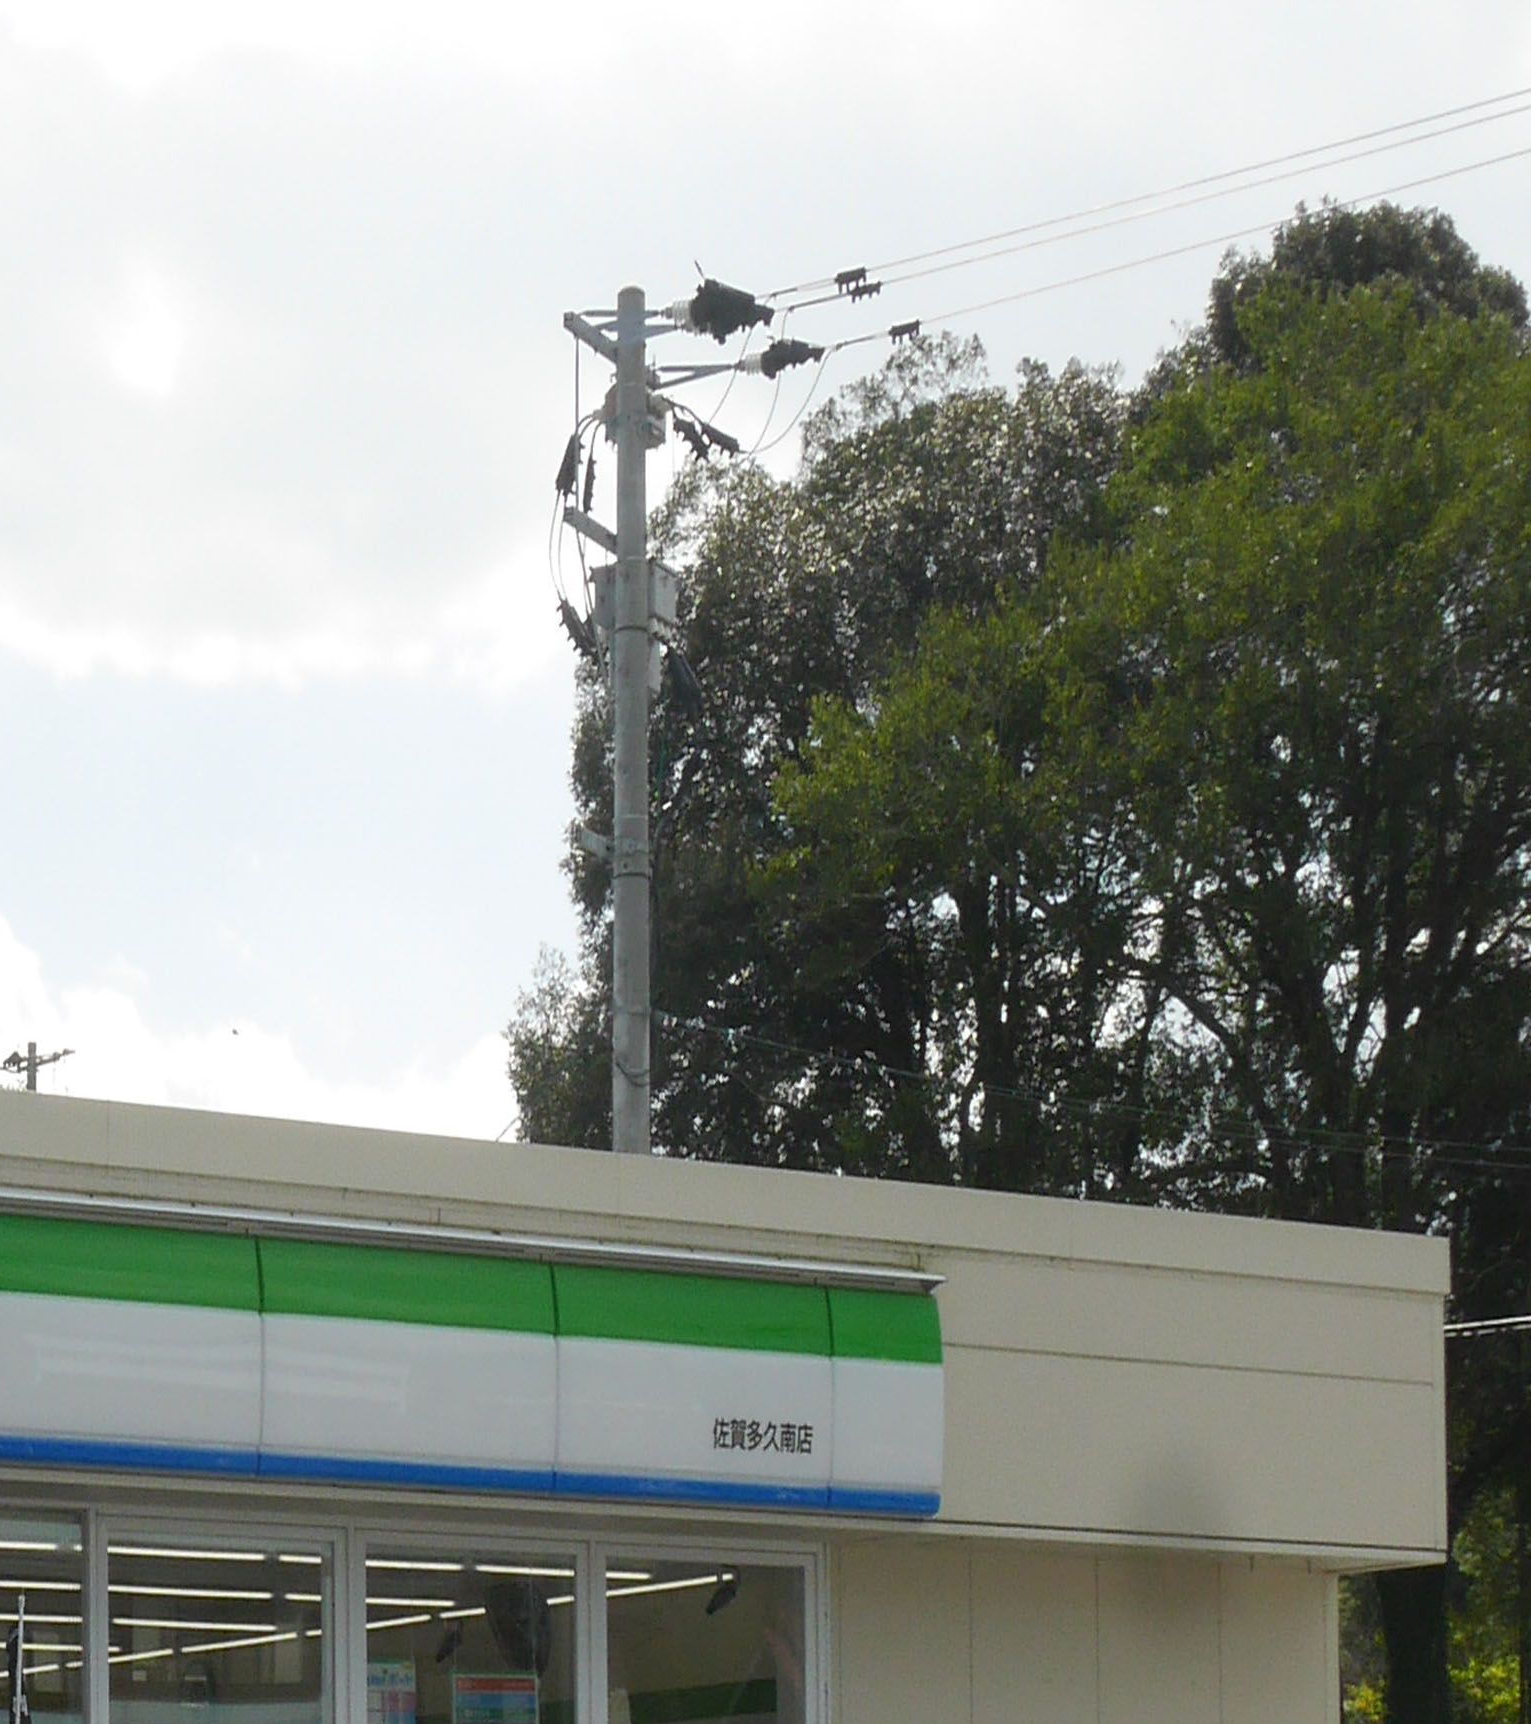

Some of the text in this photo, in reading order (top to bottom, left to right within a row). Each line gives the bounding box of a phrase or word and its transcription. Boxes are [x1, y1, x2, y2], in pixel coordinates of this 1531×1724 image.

[713, 1417, 813, 1454] 佐賀多久南店
